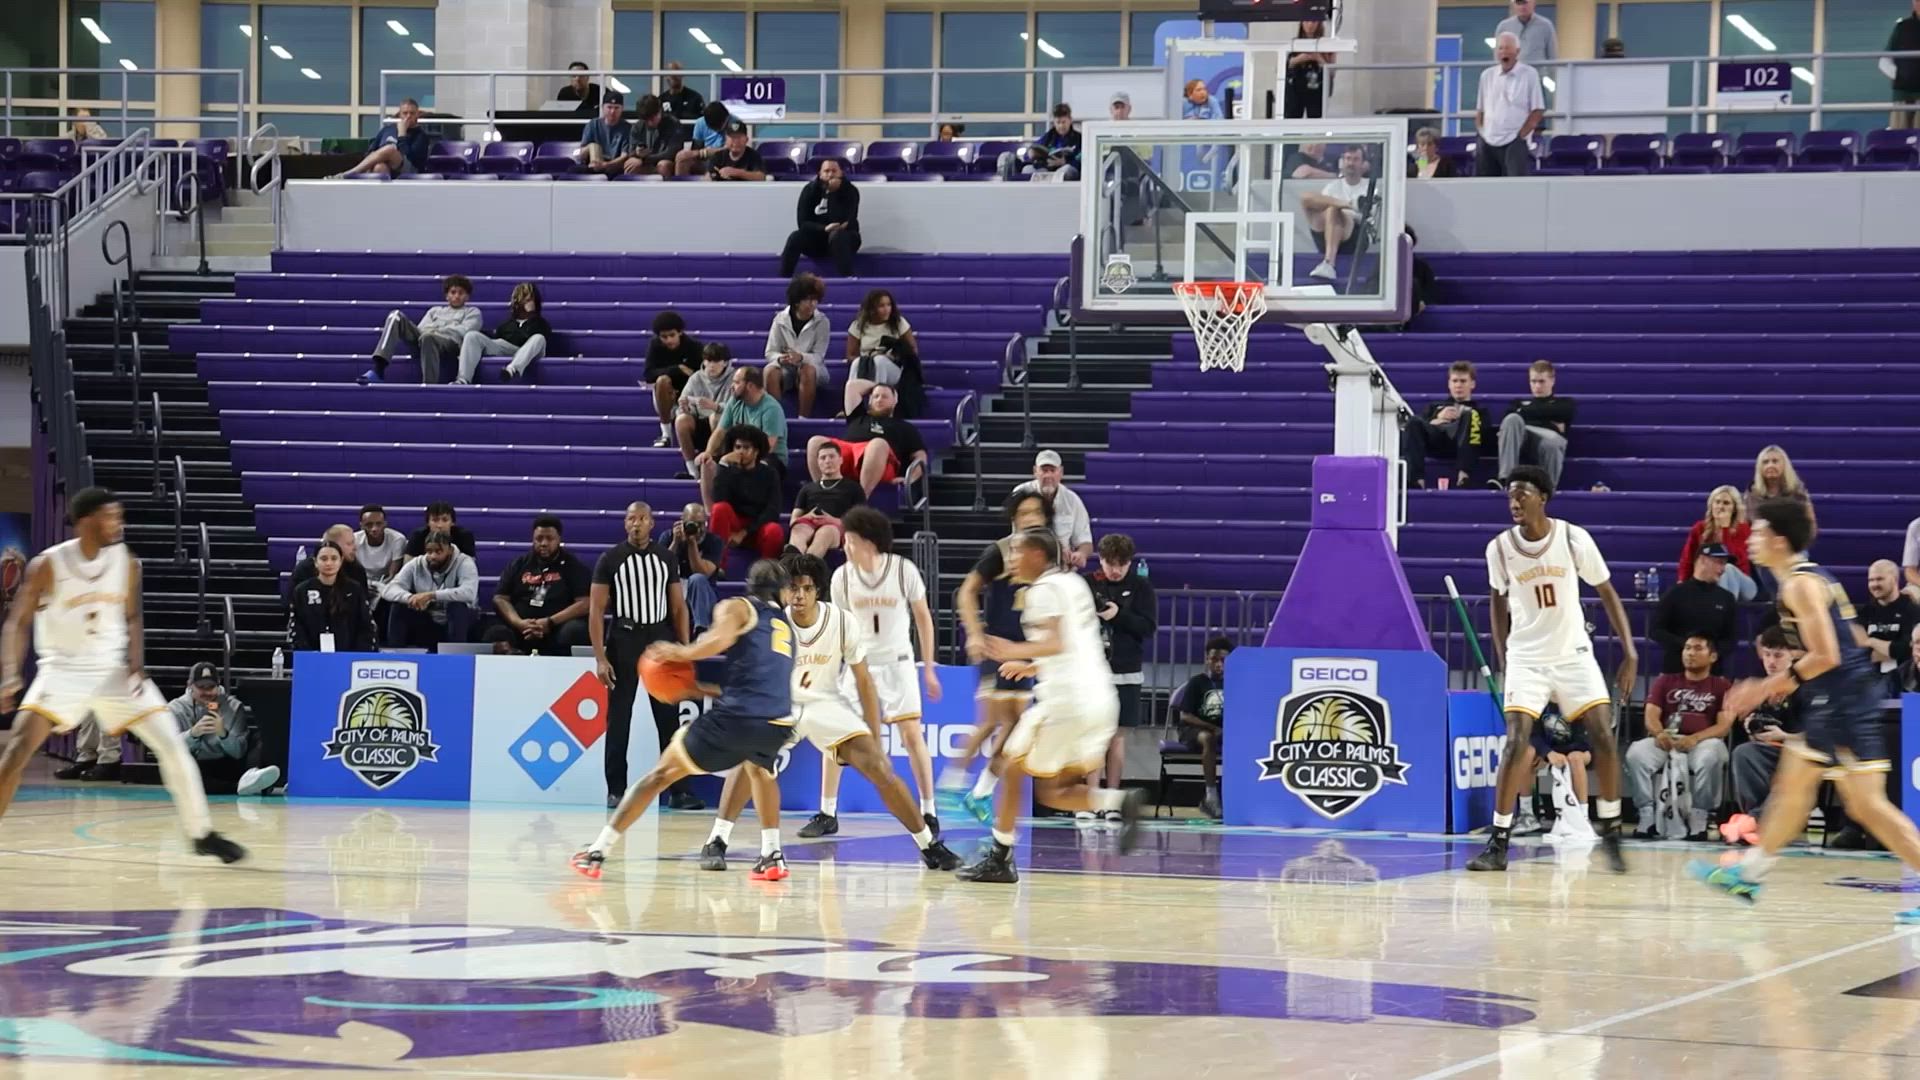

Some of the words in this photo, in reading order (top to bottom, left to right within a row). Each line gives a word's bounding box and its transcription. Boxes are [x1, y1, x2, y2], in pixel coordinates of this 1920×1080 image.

[1744, 67, 1779, 87] 102
[744, 82, 772, 100] 101
[1535, 583, 1556, 609] 10
[873, 613, 880, 635] 1
[770, 617, 793, 658] 2
[357, 668, 410, 680] GEICO
[1299, 667, 1368, 681] GEICO
[338, 728, 367, 744] CITY
[369, 728, 389, 742] OF
[391, 729, 425, 746] PALMS
[351, 747, 407, 765] CLASSIC
[1277, 742, 1314, 762] CITY
[1317, 742, 1342, 758] OF
[1345, 742, 1391, 765] PALMS
[1294, 765, 1368, 788] CLASSIC
